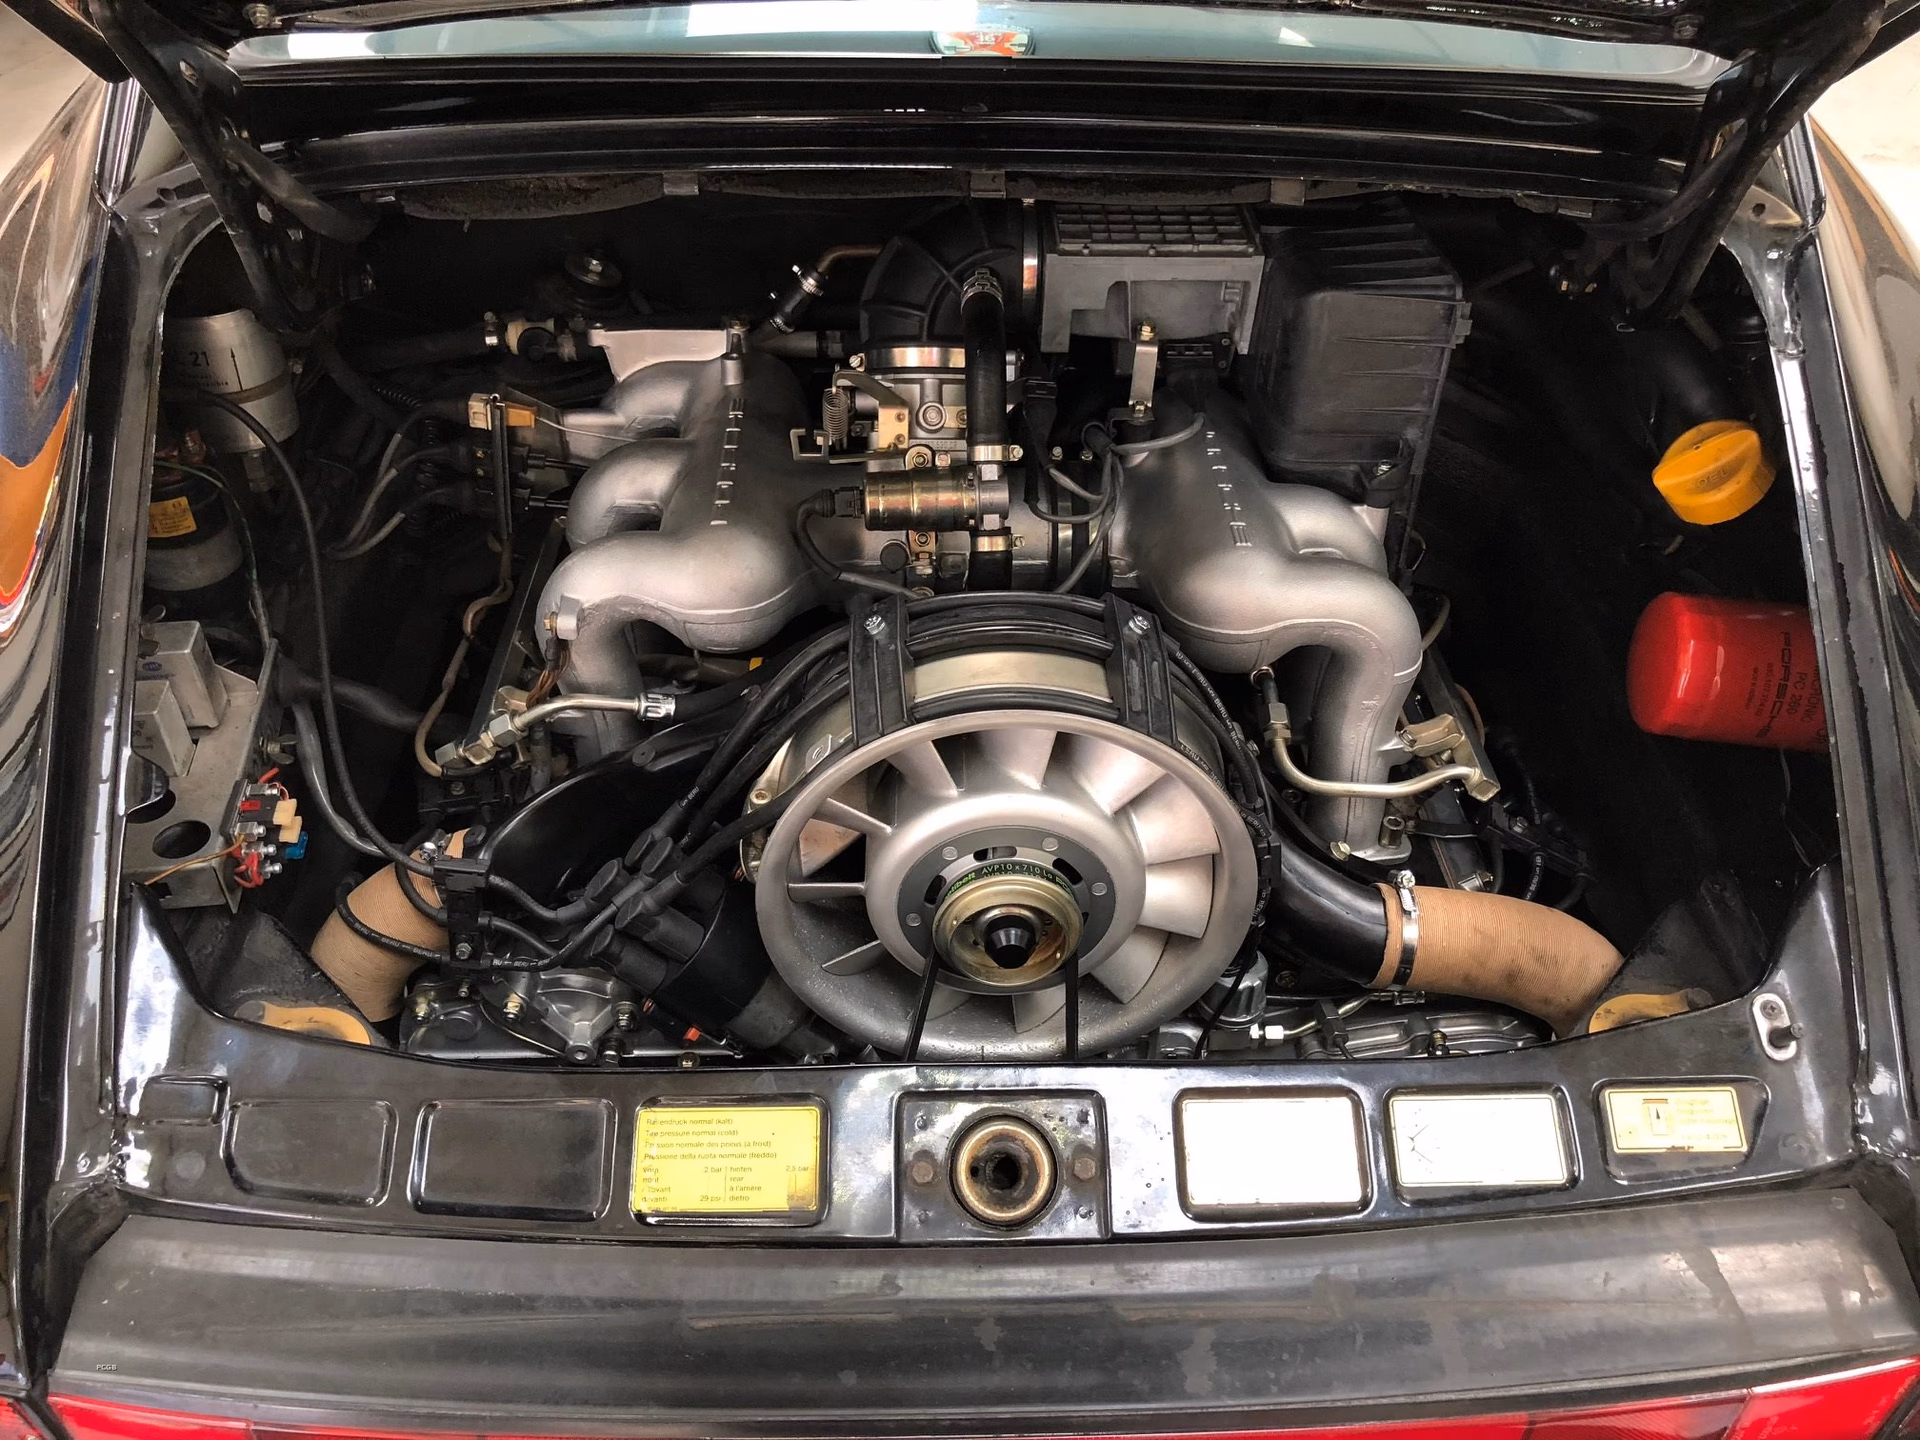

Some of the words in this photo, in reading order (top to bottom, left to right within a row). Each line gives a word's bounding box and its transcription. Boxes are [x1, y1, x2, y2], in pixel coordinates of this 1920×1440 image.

[1755, 631, 1792, 738] PORSCHE
[981, 863, 1013, 875] AVP10
[1022, 864, 1041, 875] 710
[689, 1118, 714, 1126] normal
[659, 1130, 691, 1138] pressure
[691, 1129, 716, 1137] normal
[675, 1140, 705, 1149] normale
